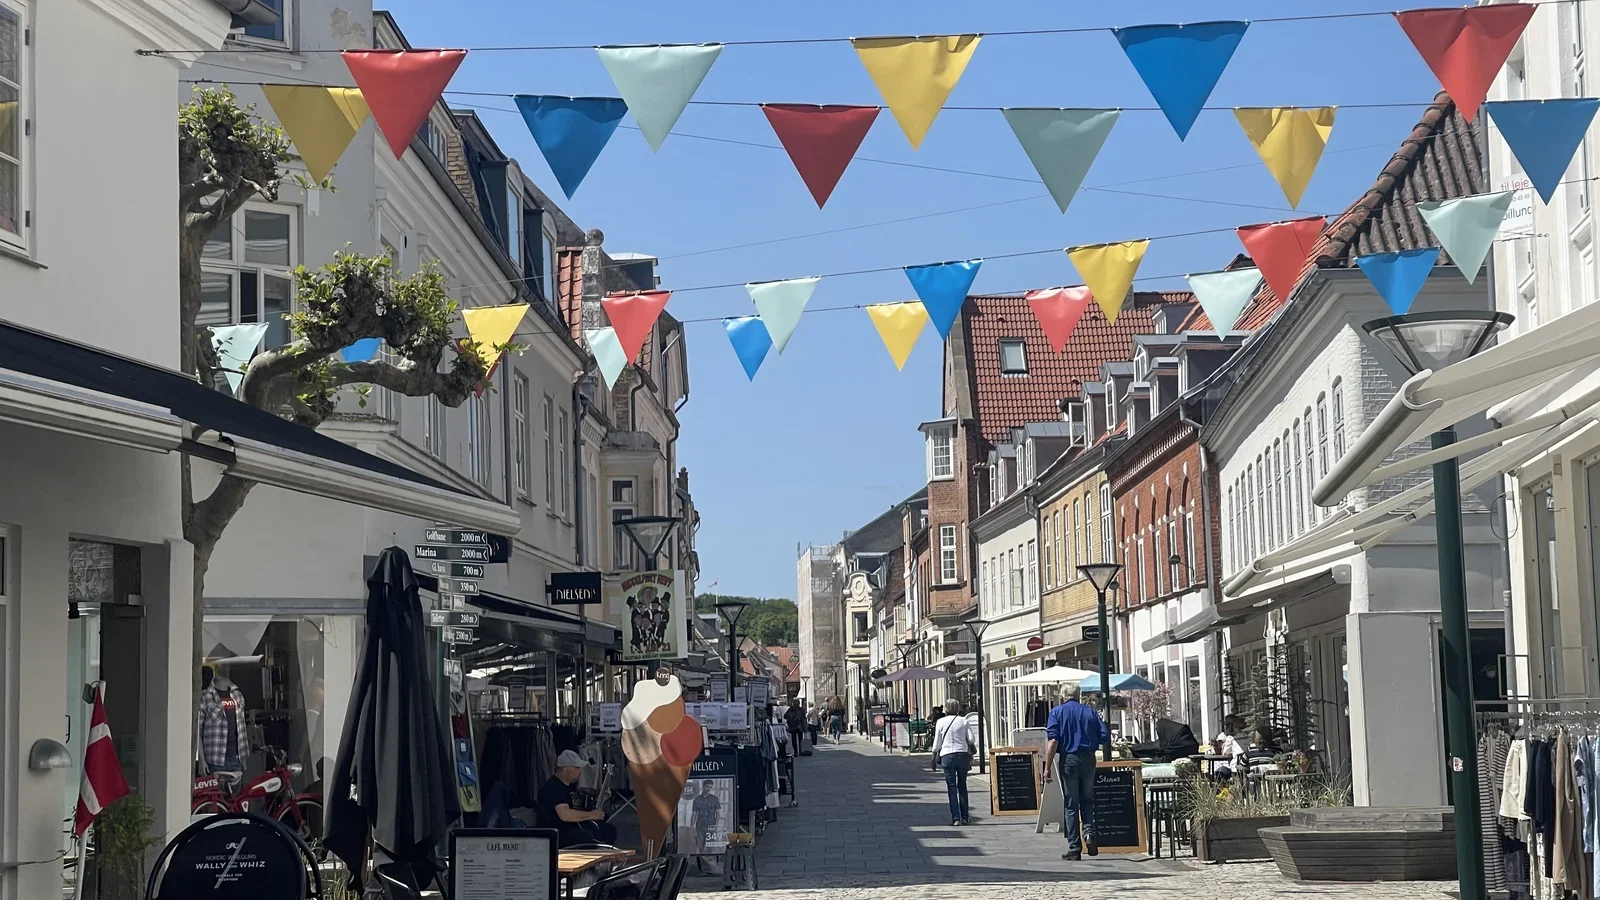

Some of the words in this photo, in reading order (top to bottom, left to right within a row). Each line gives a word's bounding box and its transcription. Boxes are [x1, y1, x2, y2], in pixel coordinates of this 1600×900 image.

[1500, 180, 1509, 192] til
[1511, 178, 1529, 191] leje
[426, 530, 446, 541] Golfbane
[416, 546, 437, 557] Marina
[502, 843, 519, 851] MENU
[227, 853, 257, 861] WNEGUMS
[195, 862, 227, 870] WALLY
[239, 860, 266, 868] WHIZ
